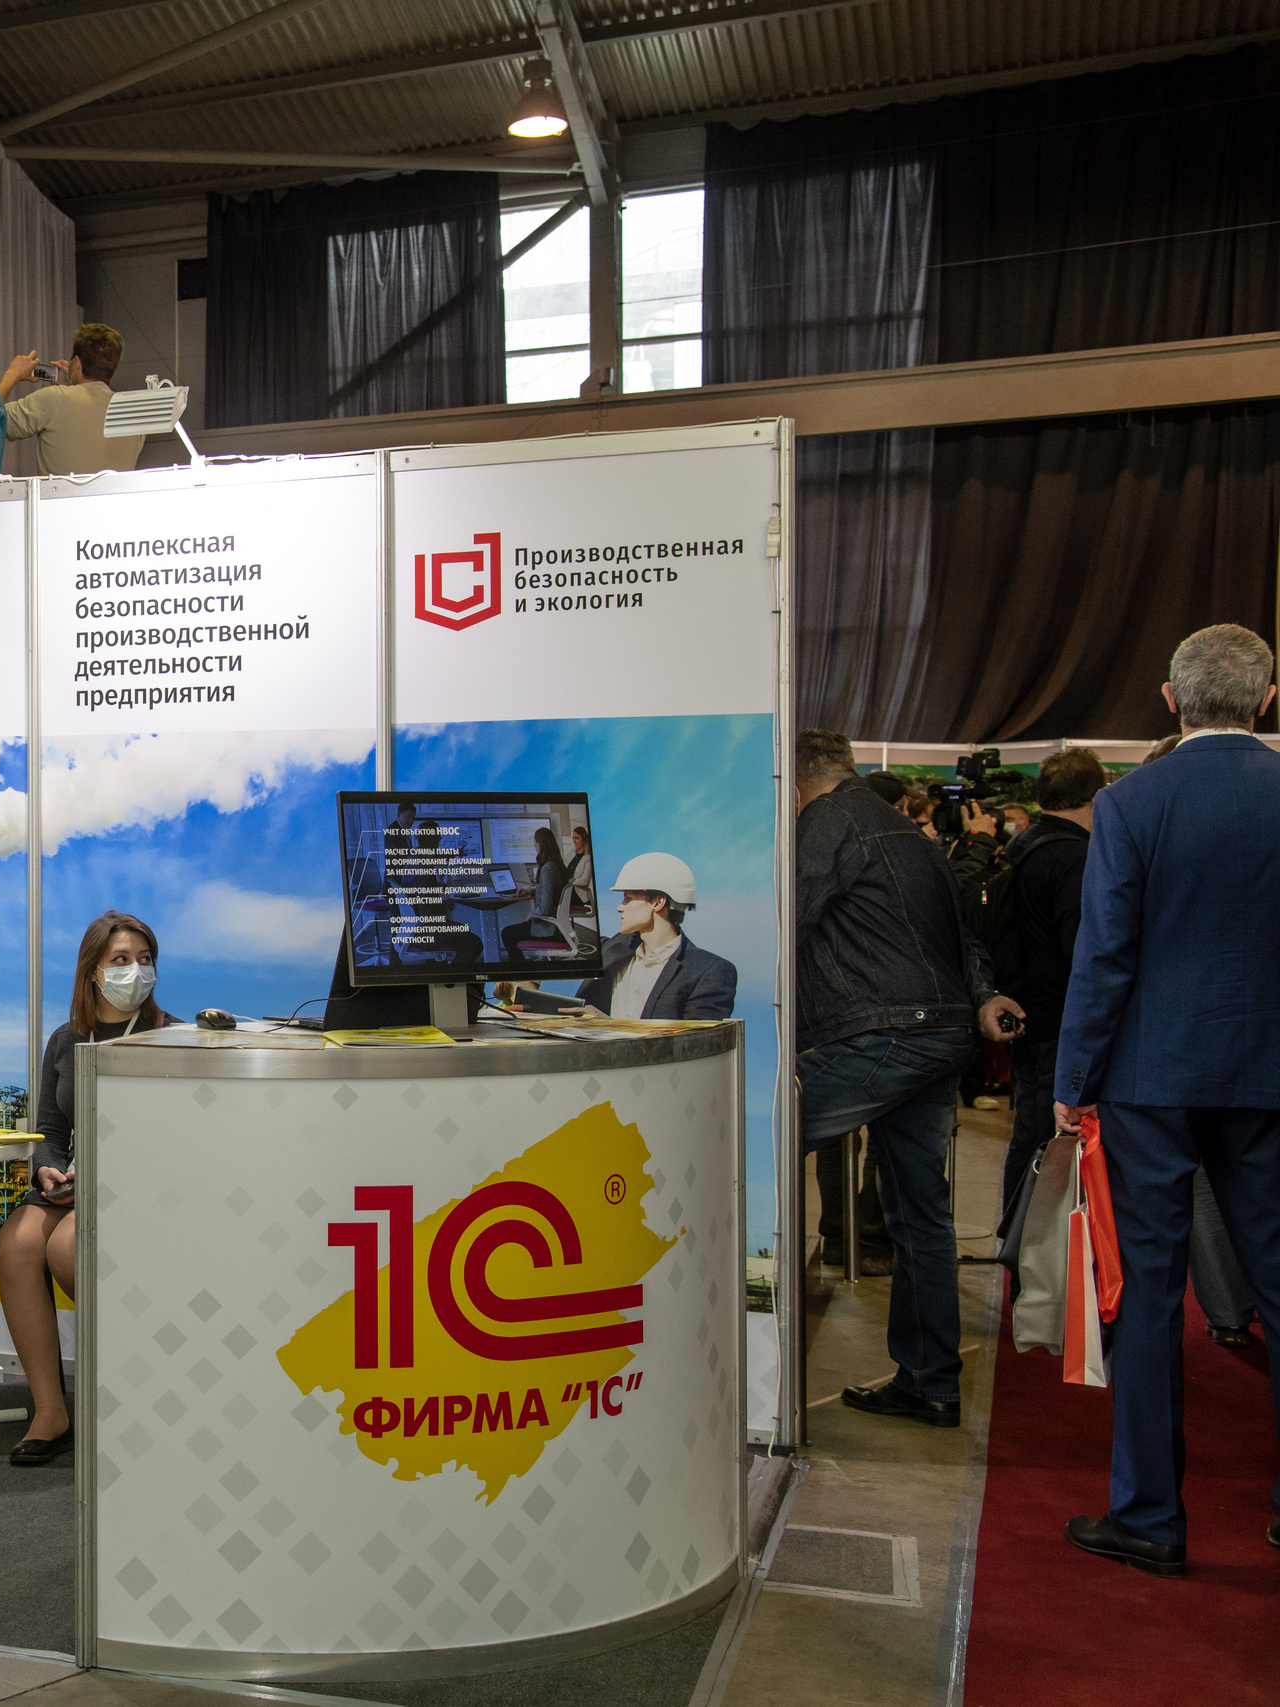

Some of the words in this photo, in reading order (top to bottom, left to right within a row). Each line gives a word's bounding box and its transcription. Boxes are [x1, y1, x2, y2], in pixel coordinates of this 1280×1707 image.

[76, 535, 235, 562] Комплексная
[515, 538, 743, 571] Производственная
[75, 563, 262, 590] автоматизация
[514, 566, 678, 590] безопасность
[75, 595, 244, 619] безопасности
[515, 598, 528, 613] и
[534, 592, 644, 613] экология
[75, 614, 310, 653] производственной
[74, 655, 243, 682] деятельности
[75, 685, 236, 712] предприятия
[382, 828, 400, 836] УЧЕТ
[400, 828, 436, 836] ОБЪЕКТОВ
[436, 826, 460, 836] НВОС
[384, 848, 409, 856] РАСЧЕТ
[409, 848, 436, 856] СУММЫ
[436, 847, 460, 855] ПЛАТЫ
[391, 858, 448, 866] ФОРМИРОВАНИЕ
[448, 857, 492, 867] ДЕКЛАРАЦИИ
[386, 868, 395, 876] ЗА
[396, 868, 437, 876] НЕГАТИВНОЕ
[438, 866, 484, 876] ВОЗДЕЙСТВИЕ
[387, 886, 444, 895] ФОРМИРОВАНИЕ
[444, 886, 488, 895] ДЕКЛАРАЦИИ
[395, 895, 442, 905] ВОЗДЕЙСТВИИ
[390, 915, 446, 924] ФОРМИРОВАНИЕ
[391, 923, 470, 934] РЕГЛАМЕНТИРОВАННОЙ
[391, 936, 435, 945] ОТЧЕТНОСТИ
[352, 1388, 550, 1440] ФИРМА
